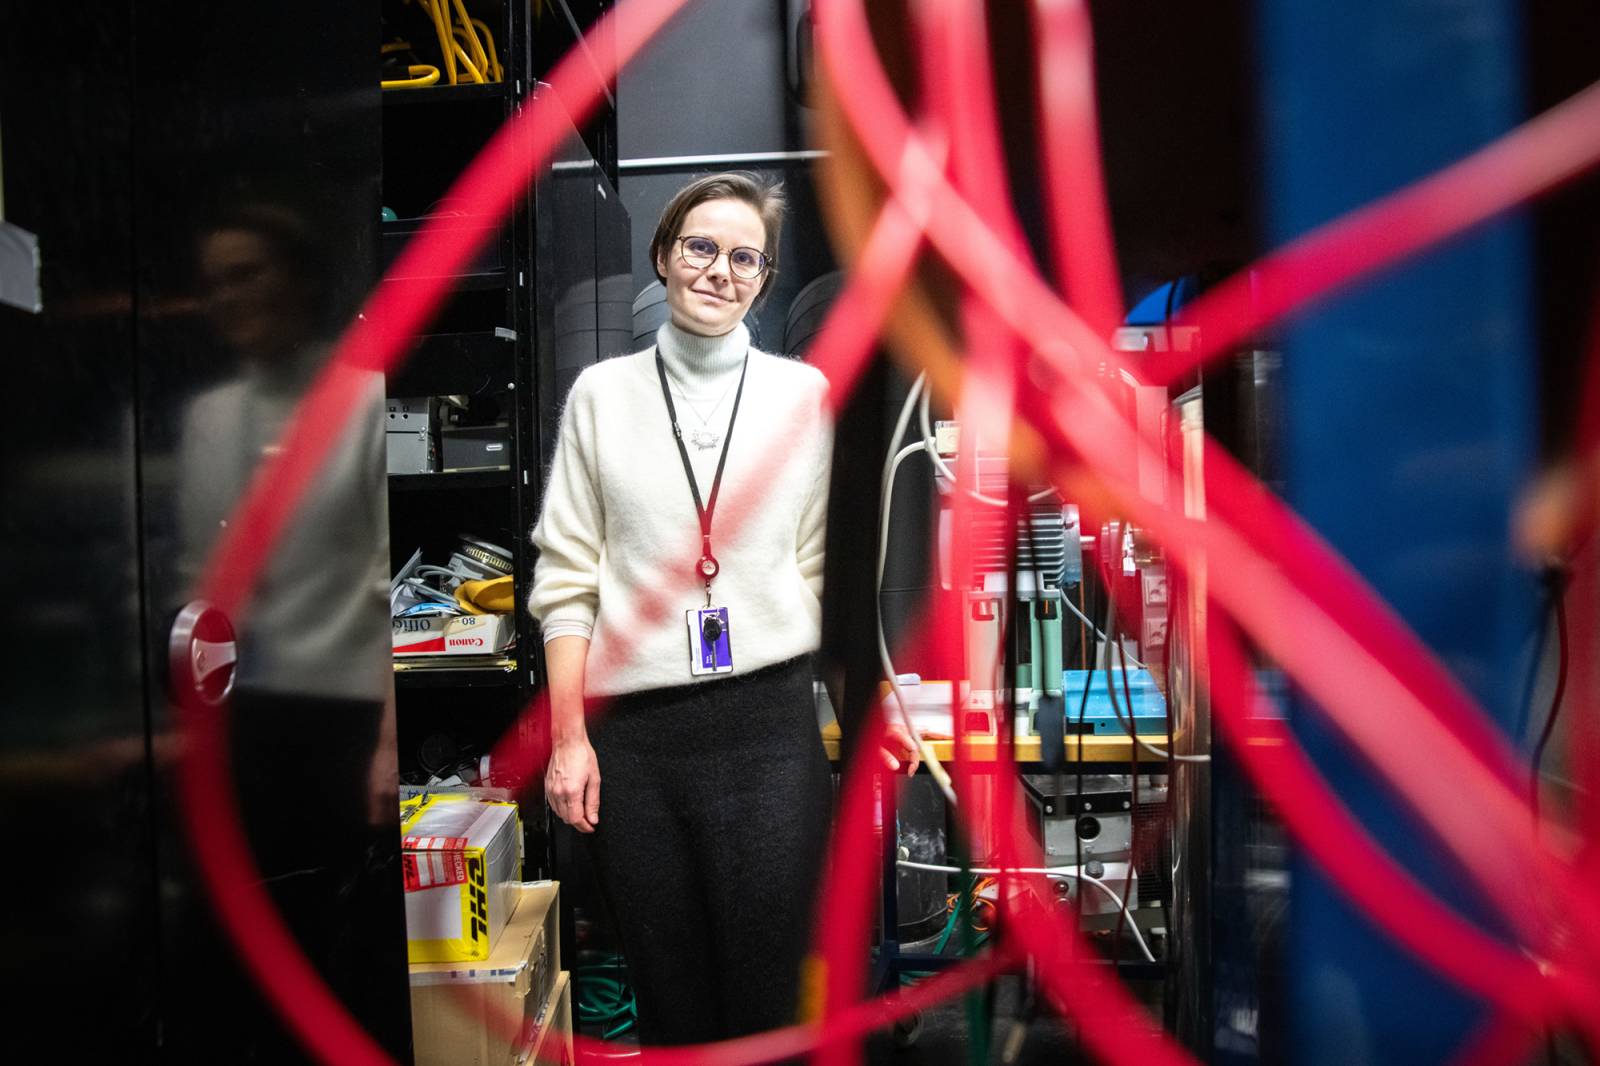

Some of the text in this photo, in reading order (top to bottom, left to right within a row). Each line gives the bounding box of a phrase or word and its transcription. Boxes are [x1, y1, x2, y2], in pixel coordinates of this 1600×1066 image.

[462, 617, 476, 626] 80
[449, 638, 484, 647] Canon
[467, 854, 487, 942] DHL
